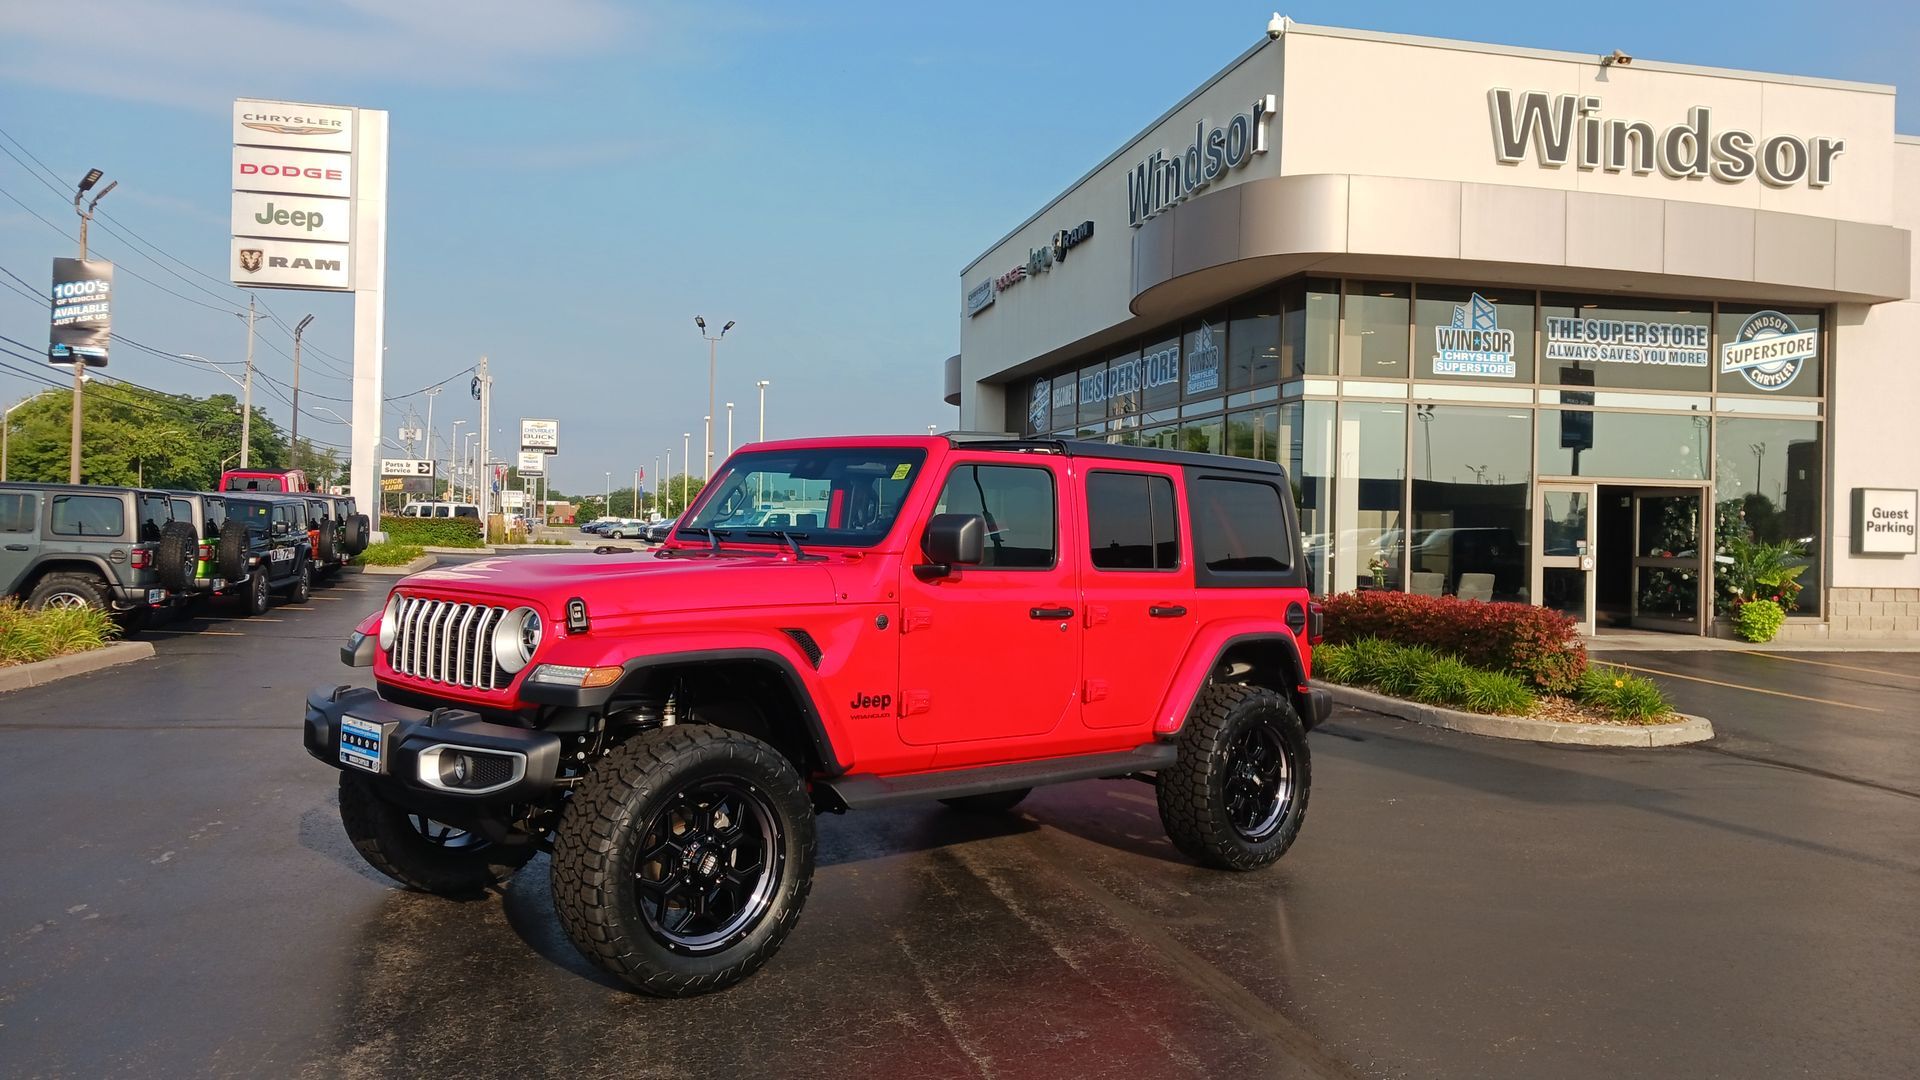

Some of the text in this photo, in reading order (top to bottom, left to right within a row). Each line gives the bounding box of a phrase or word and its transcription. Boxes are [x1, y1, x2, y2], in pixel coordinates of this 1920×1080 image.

[243, 113, 342, 127] CHRYSLER
[1488, 87, 1846, 187] Windsor
[1126, 94, 1277, 228] Windsor
[240, 163, 343, 180] DODGE
[255, 202, 324, 232] Jeep
[1062, 221, 1094, 249] RAM
[268, 256, 341, 271] RAM
[56, 293, 106, 306] OF VEHICLES
[53, 303, 109, 319] AVAILABLE
[53, 317, 75, 326] JUST
[76, 314, 93, 323] ASK
[1549, 318, 1706, 346] THE SUPERSTORE
[1744, 315, 1789, 338] WINDSOR
[1438, 328, 1511, 352] WINDSOR
[1444, 352, 1504, 362] CHRYSLER
[1549, 344, 1707, 365] ALWAYS SAVES YOU MORE!
[1726, 336, 1814, 366] SUPERSTORE
[1436, 361, 1513, 374] SUPERSTORE
[1751, 362, 1796, 386] CHRYSLER
[1080, 376, 1094, 404] THE
[1872, 507, 1909, 519] Guest
[1866, 521, 1914, 536] Parking
[850, 692, 892, 710] Jeep
